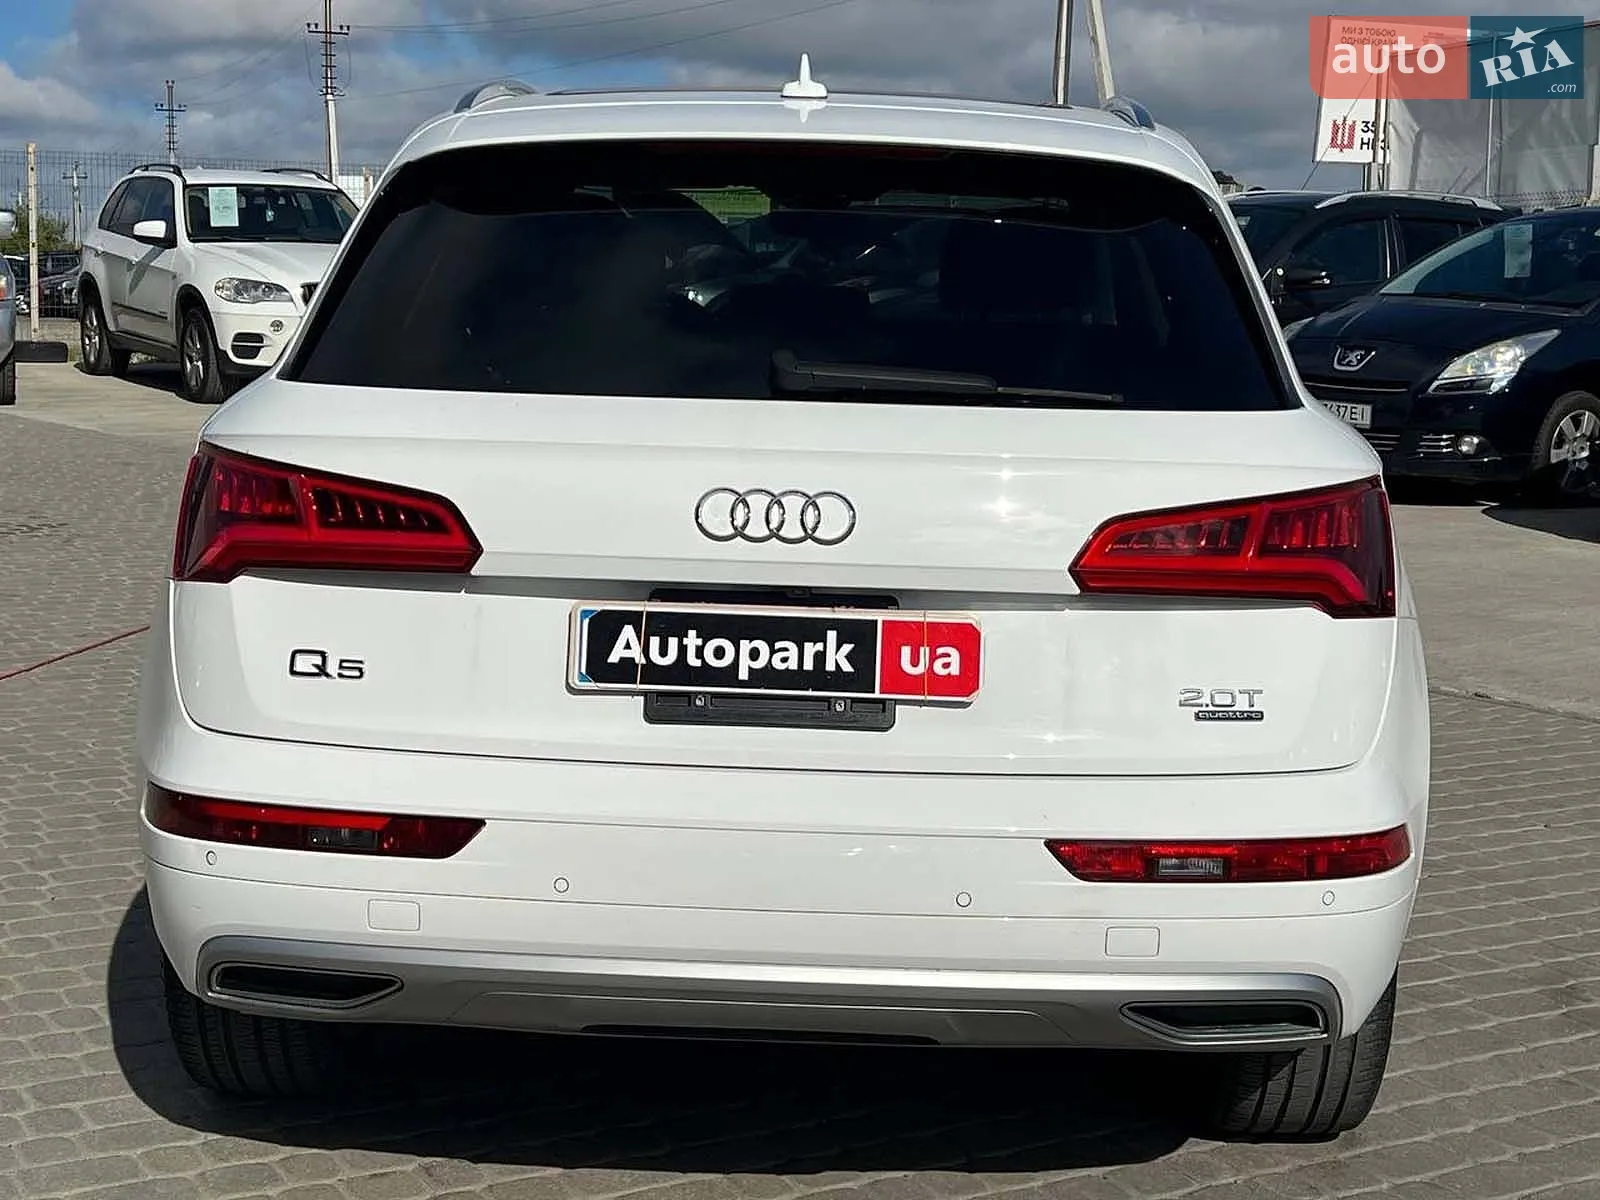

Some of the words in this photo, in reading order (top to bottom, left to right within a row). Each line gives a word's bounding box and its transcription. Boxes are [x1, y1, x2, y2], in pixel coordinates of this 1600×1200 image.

[1341, 26, 1357, 35] МИ
[1365, 28, 1396, 37] ТОБОЮ
[607, 624, 855, 680] Autopark
[900, 645, 961, 677] ua
[289, 648, 364, 679] Q5
[1179, 688, 1263, 707] 2.0T
[1197, 711, 1263, 720] quattro
